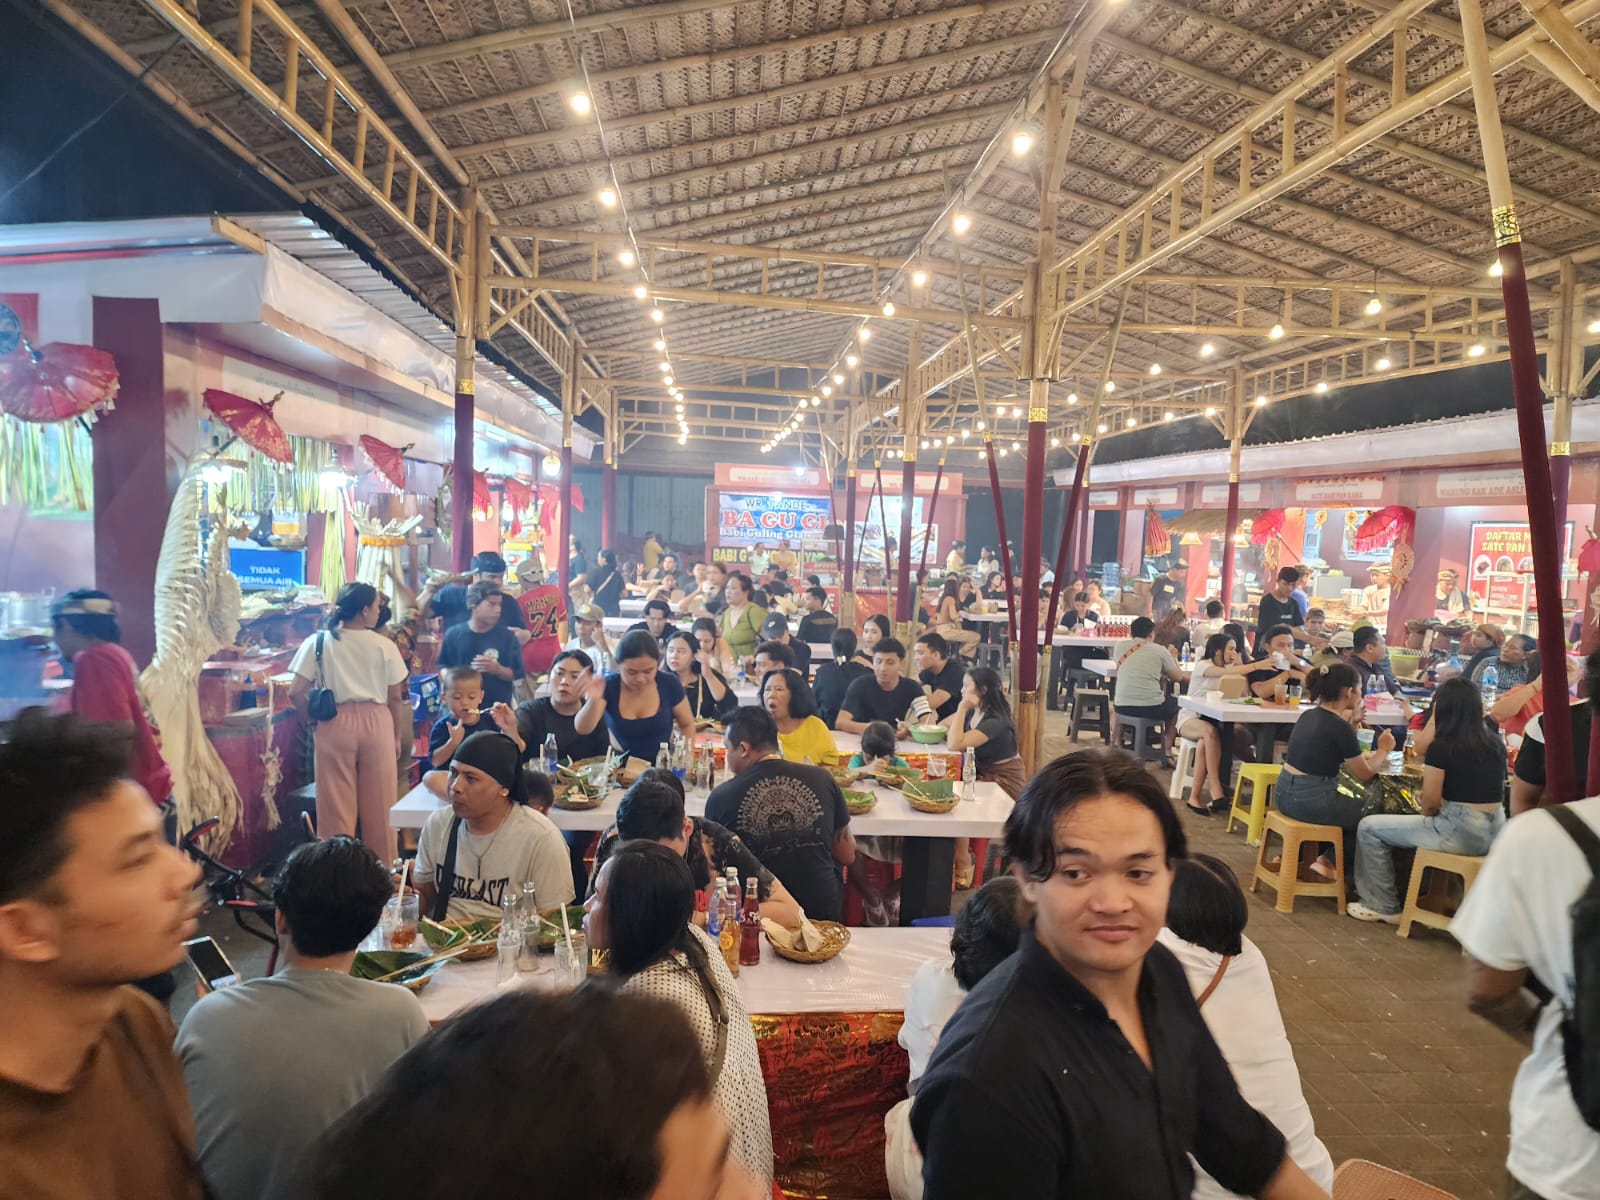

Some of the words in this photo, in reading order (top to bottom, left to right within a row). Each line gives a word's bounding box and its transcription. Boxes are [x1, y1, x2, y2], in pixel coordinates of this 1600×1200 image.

[723, 509, 756, 529] BA
[760, 512, 797, 530] GU
[746, 528, 784, 540] Guling
[1486, 530, 1522, 541] DAFTAR
[1481, 541, 1505, 552] SATE
[713, 548, 738, 563] BABI
[249, 566, 281, 574] TIDAK
[237, 575, 274, 585] SEMUA
[275, 577, 292, 585] AIR
[529, 605, 559, 639] 24
